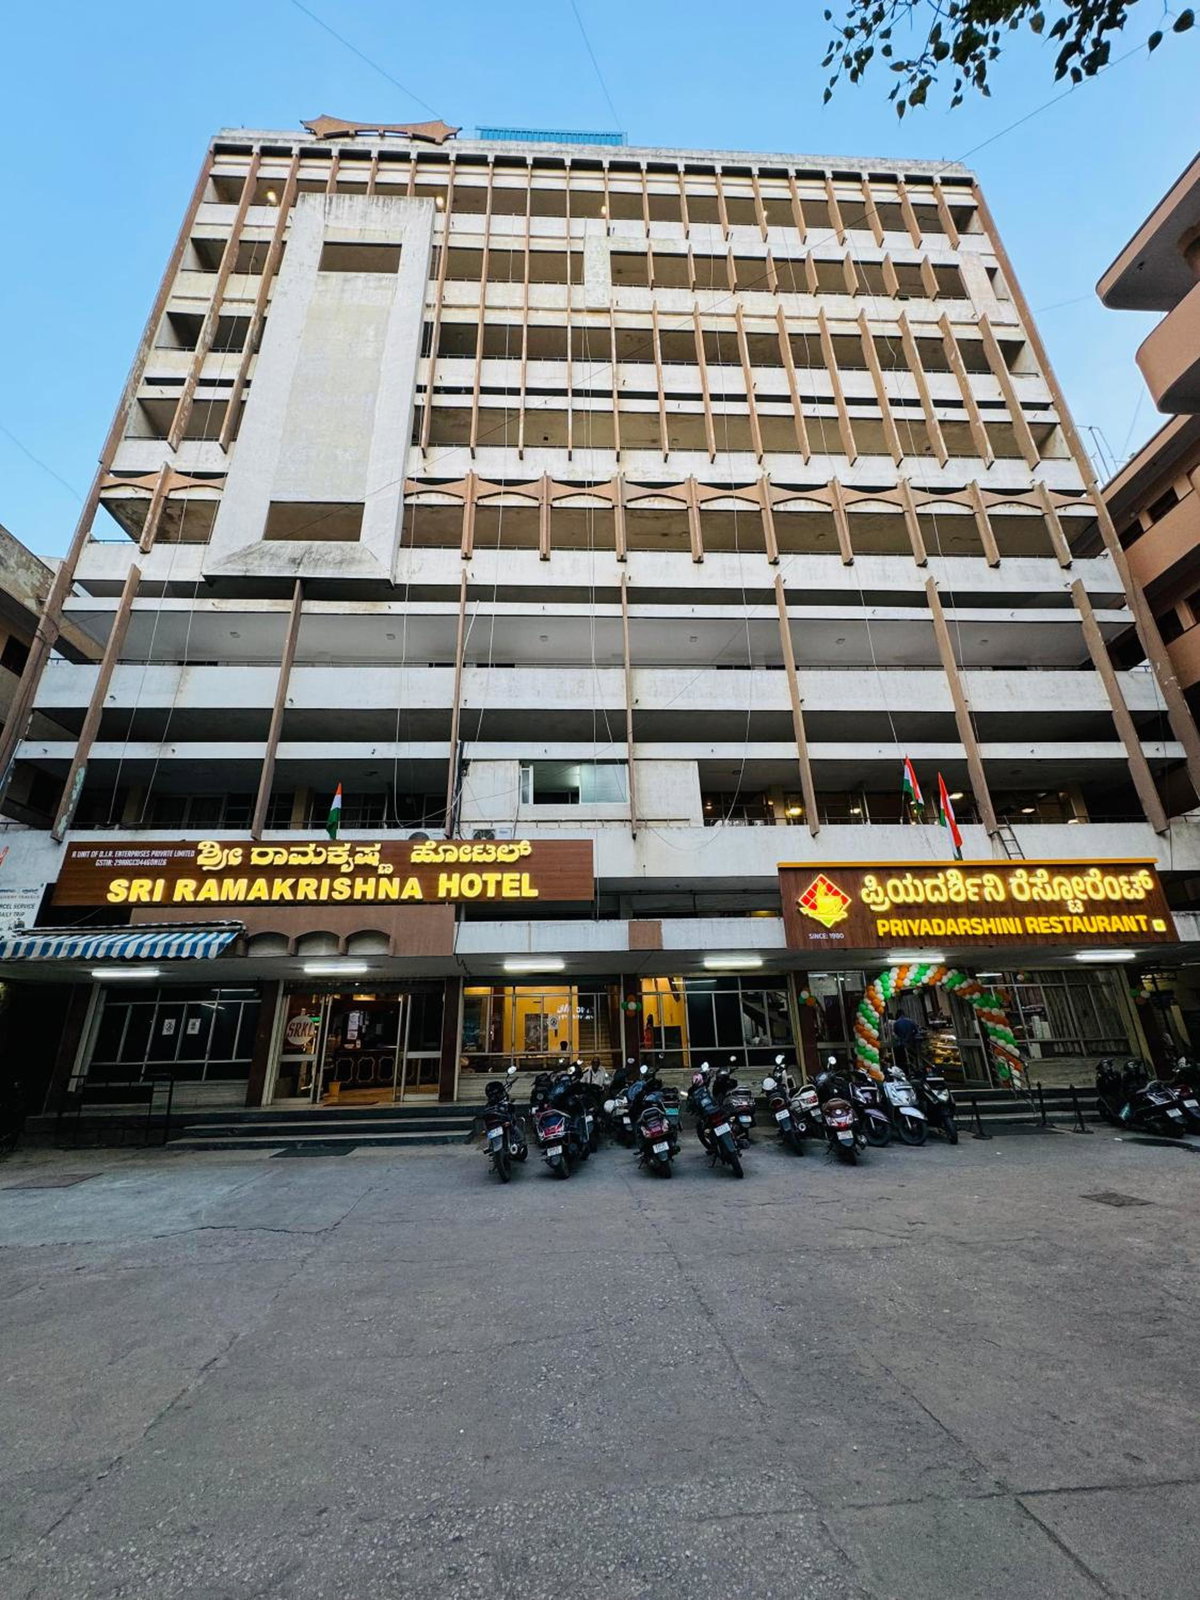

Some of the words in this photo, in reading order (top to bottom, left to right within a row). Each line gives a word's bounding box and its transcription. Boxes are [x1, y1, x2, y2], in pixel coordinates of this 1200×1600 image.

[91, 850, 99, 858] OF
[115, 850, 151, 858] ENTERPRISES
[196, 841, 243, 871] ಶ್ರೀ
[250, 843, 394, 874] ರಾಮಕೃಷ್ಣ
[106, 878, 165, 903] SRI
[172, 877, 423, 902] RAMAKRISHNA
[438, 873, 539, 898] HOTEL
[860, 868, 1006, 912] ಪ್ರಿಯದರ್ಶಿನಿ
[876, 917, 1023, 937] PRIYADARSHINI
[1024, 914, 1148, 934] RESTAURANT
